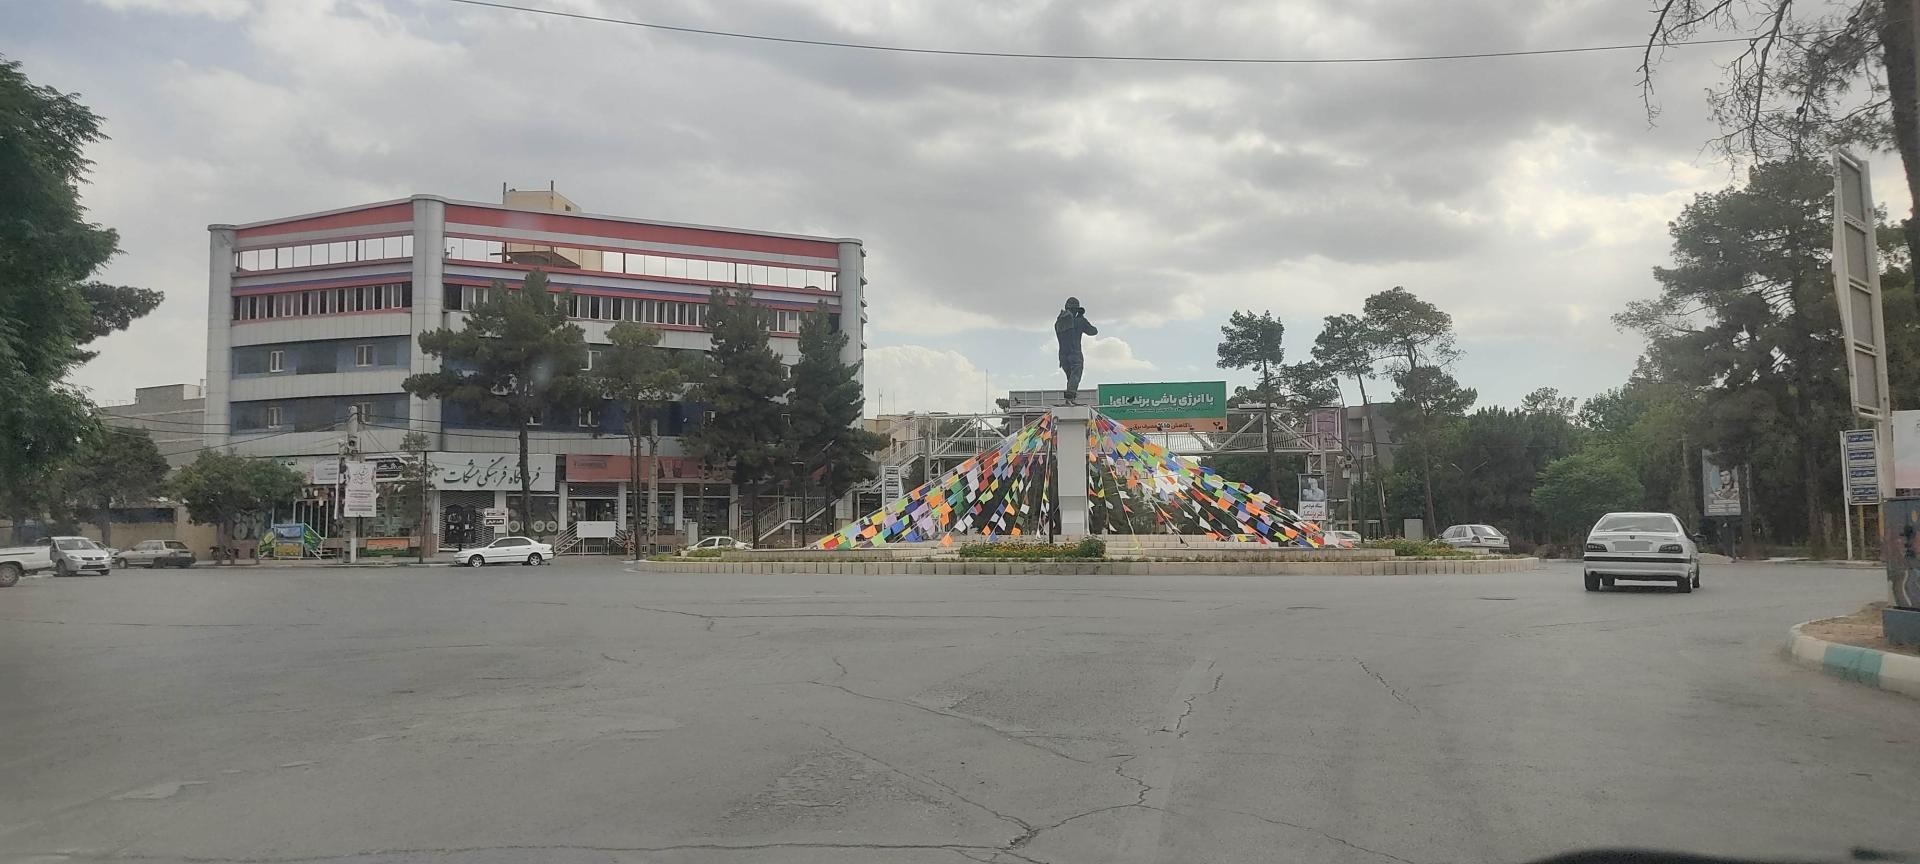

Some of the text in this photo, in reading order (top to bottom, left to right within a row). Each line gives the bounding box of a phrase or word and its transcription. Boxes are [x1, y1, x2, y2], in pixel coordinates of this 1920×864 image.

[1151, 393, 1177, 406] باشی
[1179, 393, 1205, 407] انرژی
[1206, 393, 1214, 405] با
[443, 456, 541, 487] فرگاه فرهنگی مشکات
